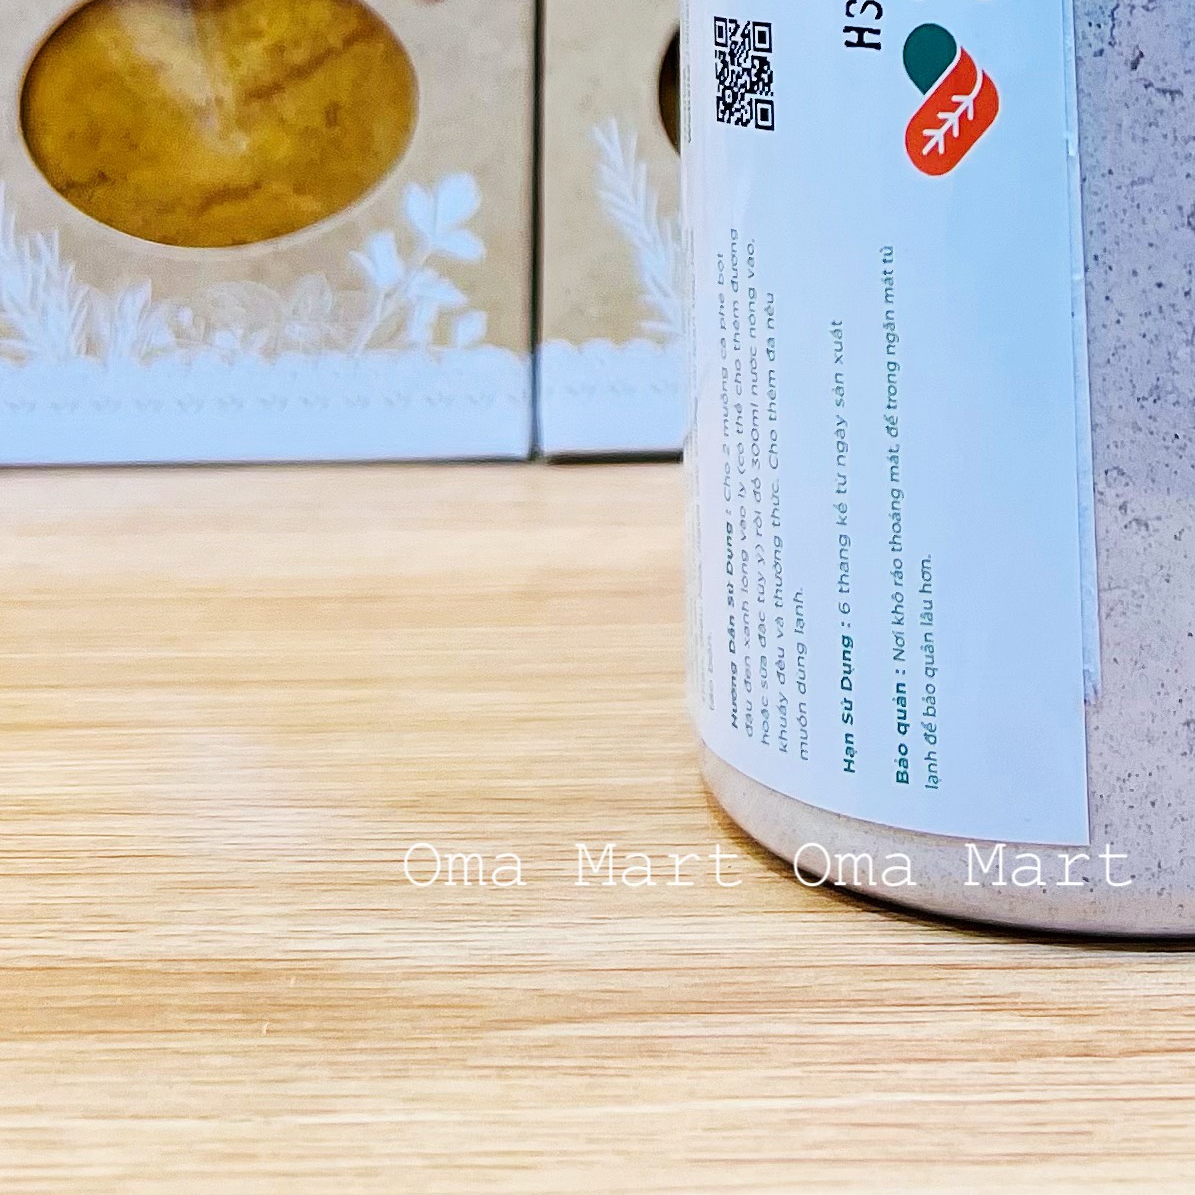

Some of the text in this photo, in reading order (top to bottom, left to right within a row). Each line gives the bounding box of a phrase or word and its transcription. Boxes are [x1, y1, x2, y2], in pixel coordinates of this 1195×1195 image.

[878, 244, 896, 264] tủ
[880, 269, 897, 304] mát
[829, 318, 845, 364] xuất
[733, 357, 743, 396] cho
[766, 368, 779, 422] thêm
[830, 371, 847, 408] sản
[883, 360, 902, 410] trong
[750, 402, 761, 470] 300ml
[768, 428, 780, 470] Cho
[886, 487, 905, 552] thoáng
[888, 557, 905, 586] ráo
[917, 553, 936, 593] hơn.
[741, 599, 752, 649] xanh
[838, 601, 851, 615] 6
[890, 591, 907, 626] khô
[918, 597, 936, 626] lâu
[840, 633, 857, 692] Dụng
[890, 631, 907, 662] Nơi
[891, 681, 910, 736] quản
[920, 683, 939, 717] bảo
[842, 732, 859, 773] Hạn
[892, 742, 911, 784] Bảo
[924, 751, 942, 790] lạnh
